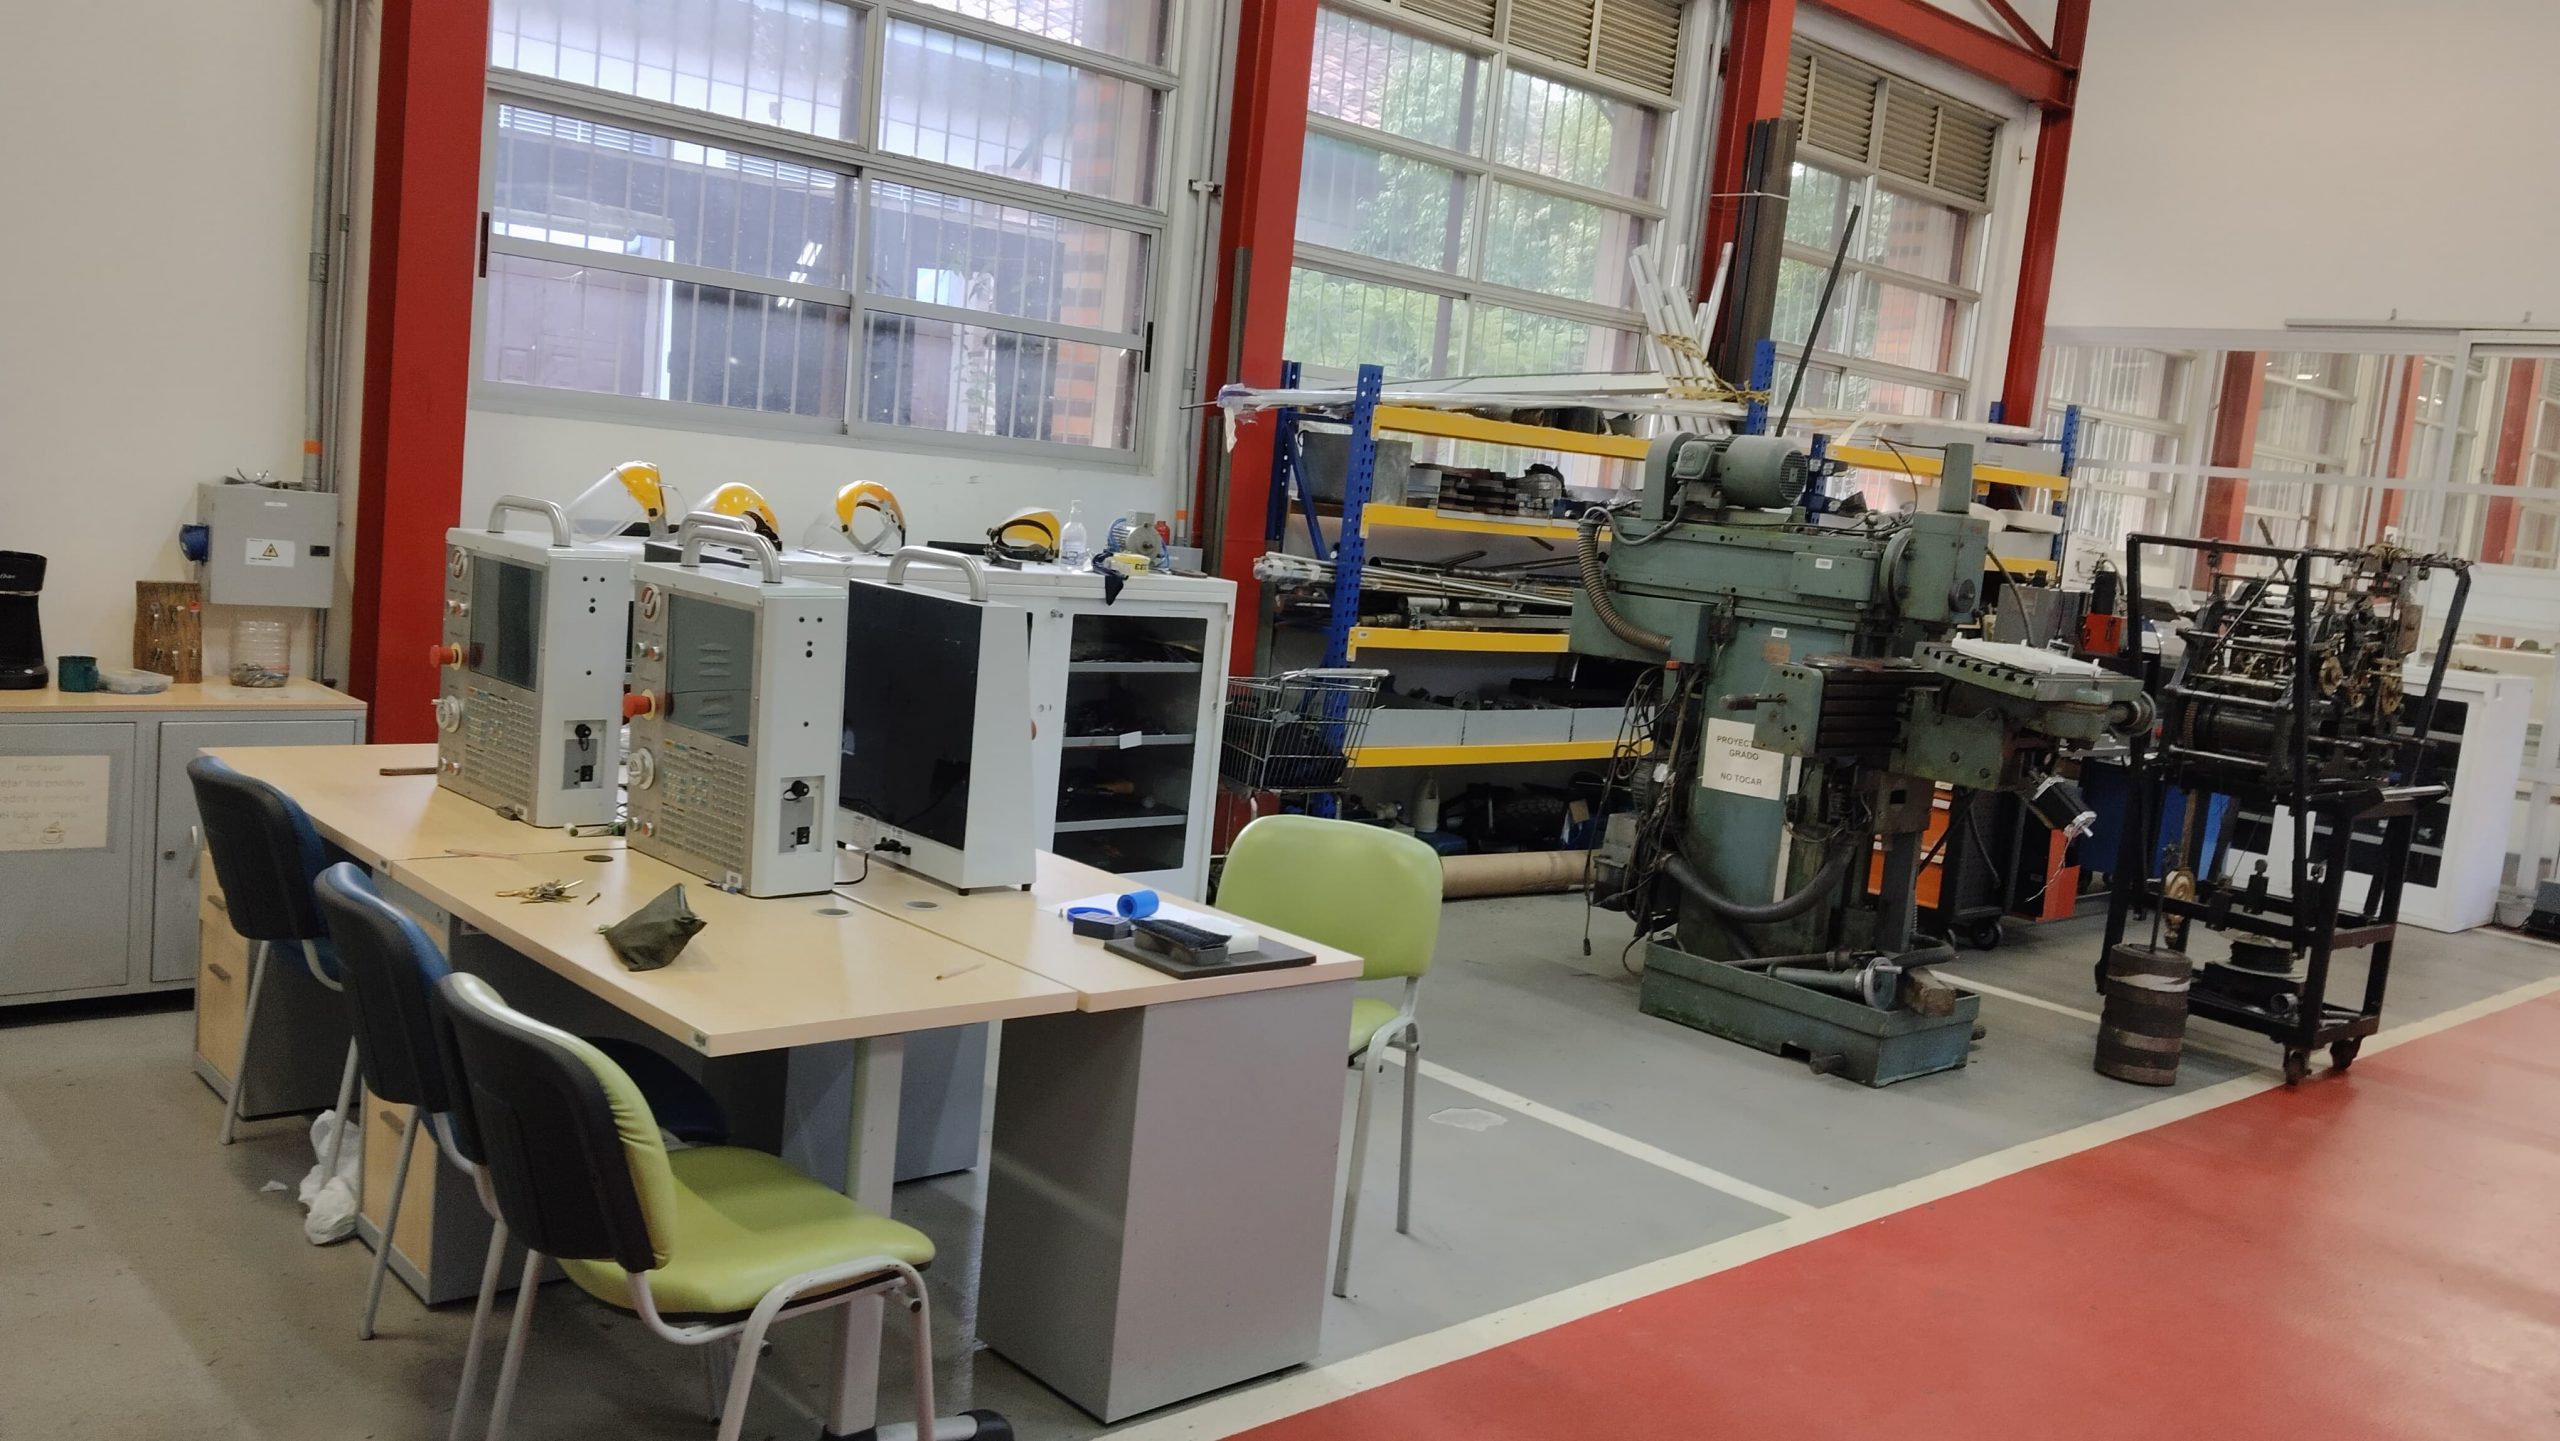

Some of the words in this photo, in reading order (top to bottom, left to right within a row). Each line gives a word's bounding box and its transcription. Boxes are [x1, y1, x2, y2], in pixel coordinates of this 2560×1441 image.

[1716, 735, 1753, 748] PROYEC
[1729, 749, 1759, 761] GRADO
[1720, 772, 1732, 781] NO
[1735, 774, 1762, 786] TOCAR
